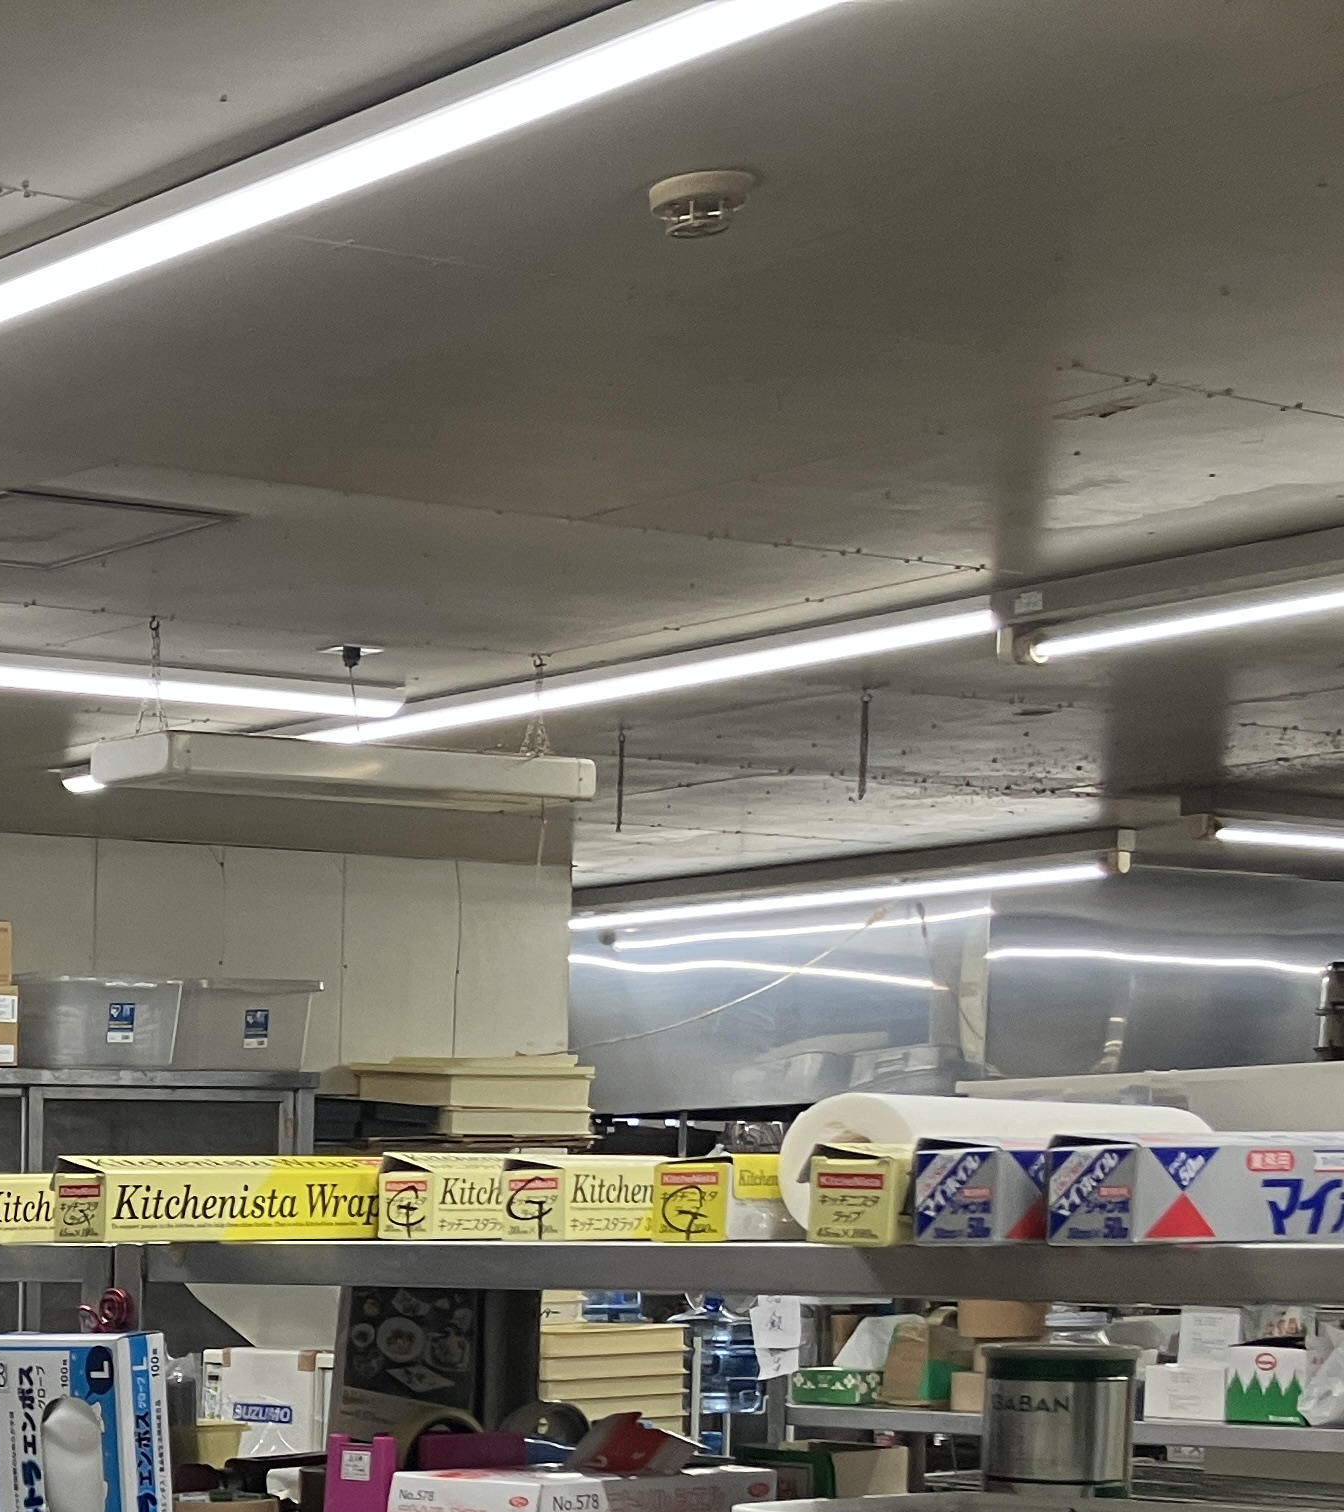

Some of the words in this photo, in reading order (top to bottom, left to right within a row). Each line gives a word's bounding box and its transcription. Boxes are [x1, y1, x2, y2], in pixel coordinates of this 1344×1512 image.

[572, 1173, 653, 1204] Kitchen
[111, 1184, 299, 1220] Kitchenista
[305, 1183, 379, 1225] Wrap
[1261, 1178, 1344, 1235] マイ
[233, 1404, 292, 1423] SUZUMO
[398, 1488, 435, 1501] No.578
[552, 1493, 600, 1512] No.578
